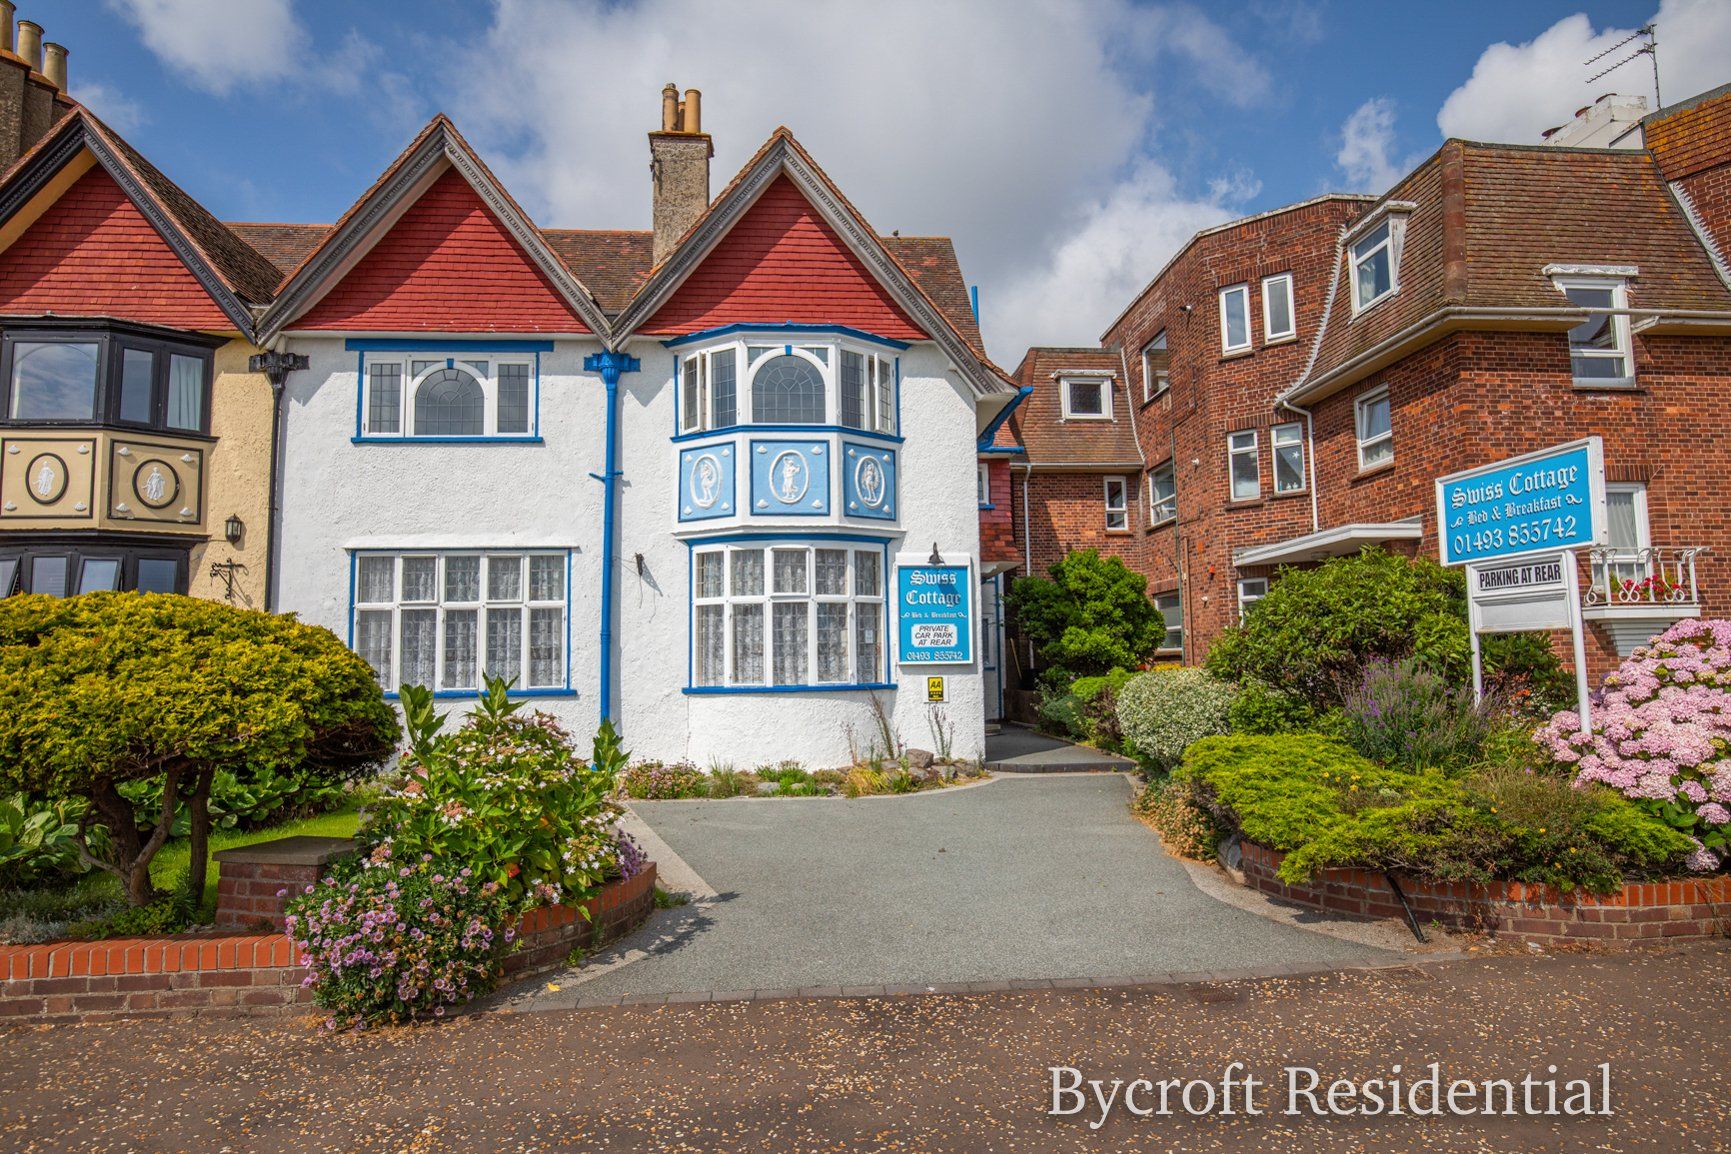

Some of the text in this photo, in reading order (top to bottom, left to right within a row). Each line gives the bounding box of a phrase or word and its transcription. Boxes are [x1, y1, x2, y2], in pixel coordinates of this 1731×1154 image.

[1451, 465, 1578, 509] Swiss Cottage
[1467, 496, 1562, 526] Bed & Breakfast
[1454, 515, 1576, 554] 01493 855742
[910, 570, 957, 586] Swiss
[1479, 564, 1561, 588] PARKING AT REAR
[905, 590, 961, 607] Cottage
[930, 680, 941, 689] AA
